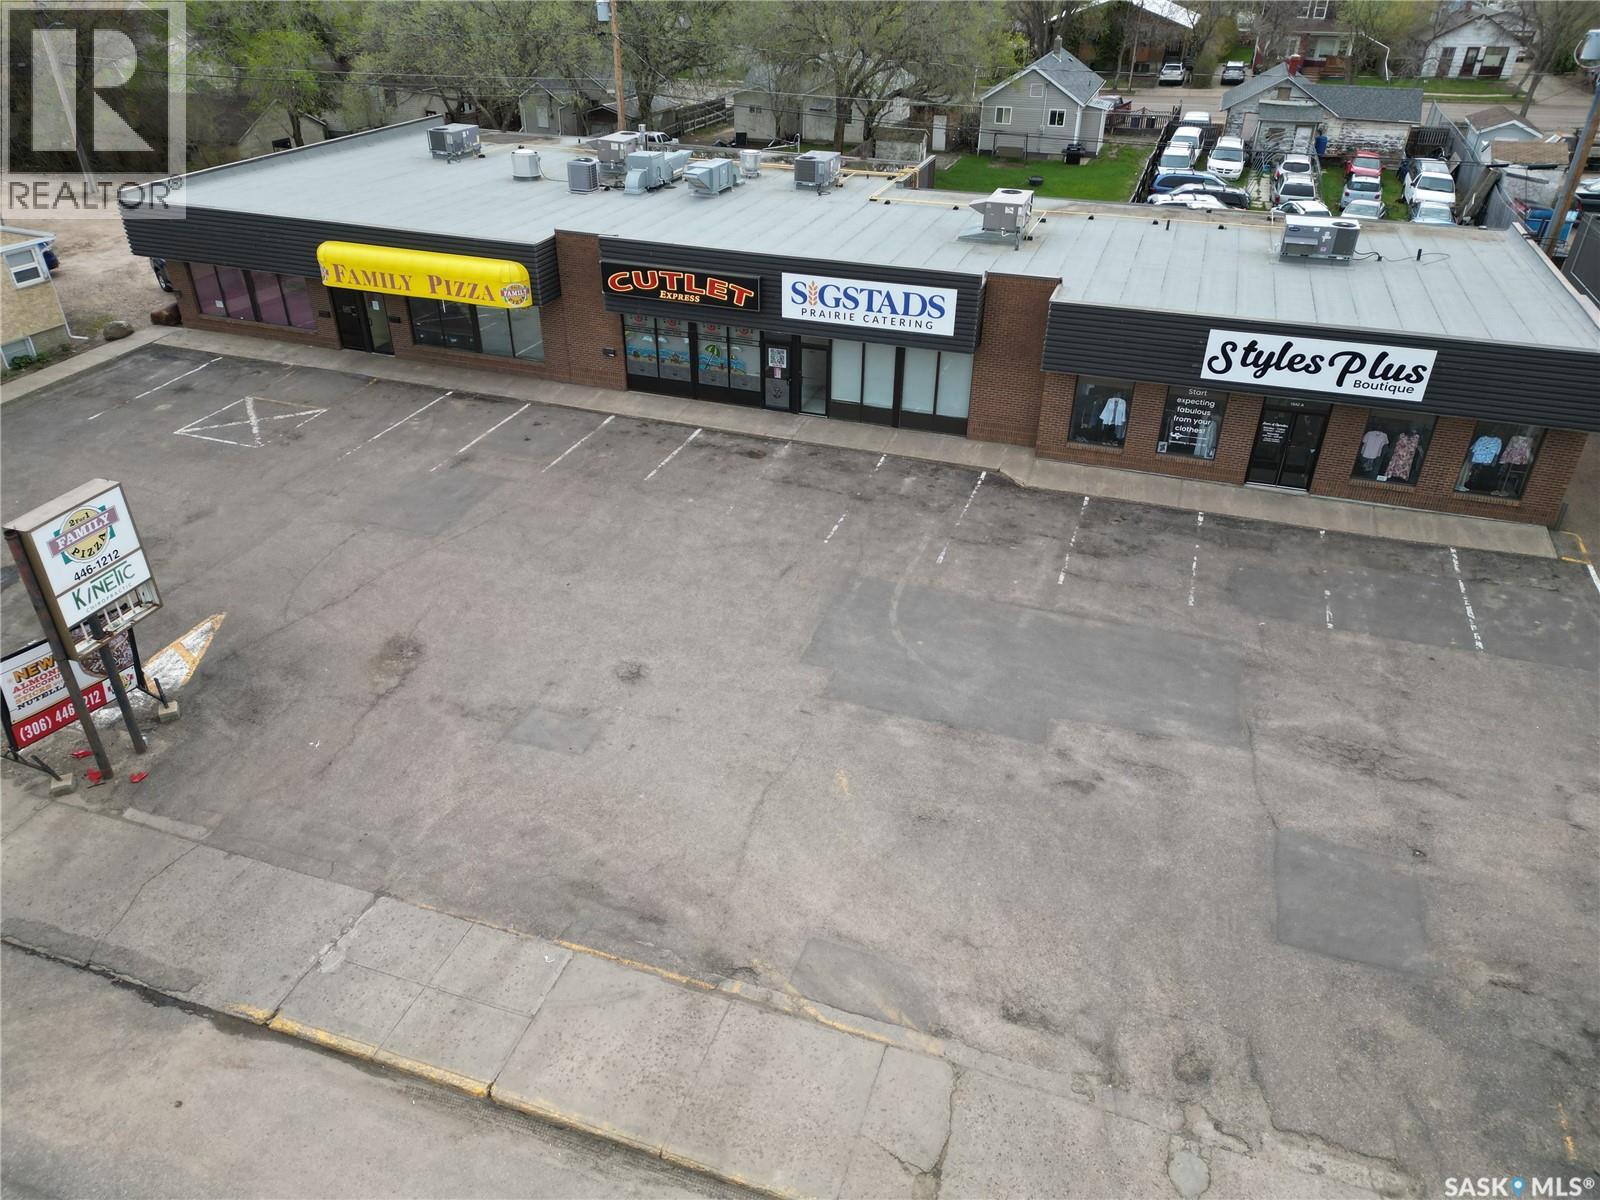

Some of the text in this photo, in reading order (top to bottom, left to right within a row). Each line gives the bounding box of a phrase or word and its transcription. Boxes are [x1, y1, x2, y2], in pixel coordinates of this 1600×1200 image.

[333, 263, 413, 291] FAMILY
[427, 274, 496, 302] PIZZA
[608, 270, 755, 307] CUTLET
[659, 290, 700, 303] EXPRESS
[801, 308, 934, 330] PRAIRIE CATERING
[1207, 339, 1428, 388] Styles Plus
[1188, 388, 1208, 396] Start
[1353, 379, 1415, 395] Boutique
[1176, 397, 1216, 409] expecting
[1176, 405, 1211, 416] fabulous
[1173, 415, 1212, 426] from your
[56, 512, 111, 550] FAMILY
[72, 533, 107, 558] PIZZA
[74, 549, 121, 581] 446-1212
[72, 561, 135, 610] KINETIC
[22, 673, 61, 695] COCONU
[19, 715, 52, 742] (306)
